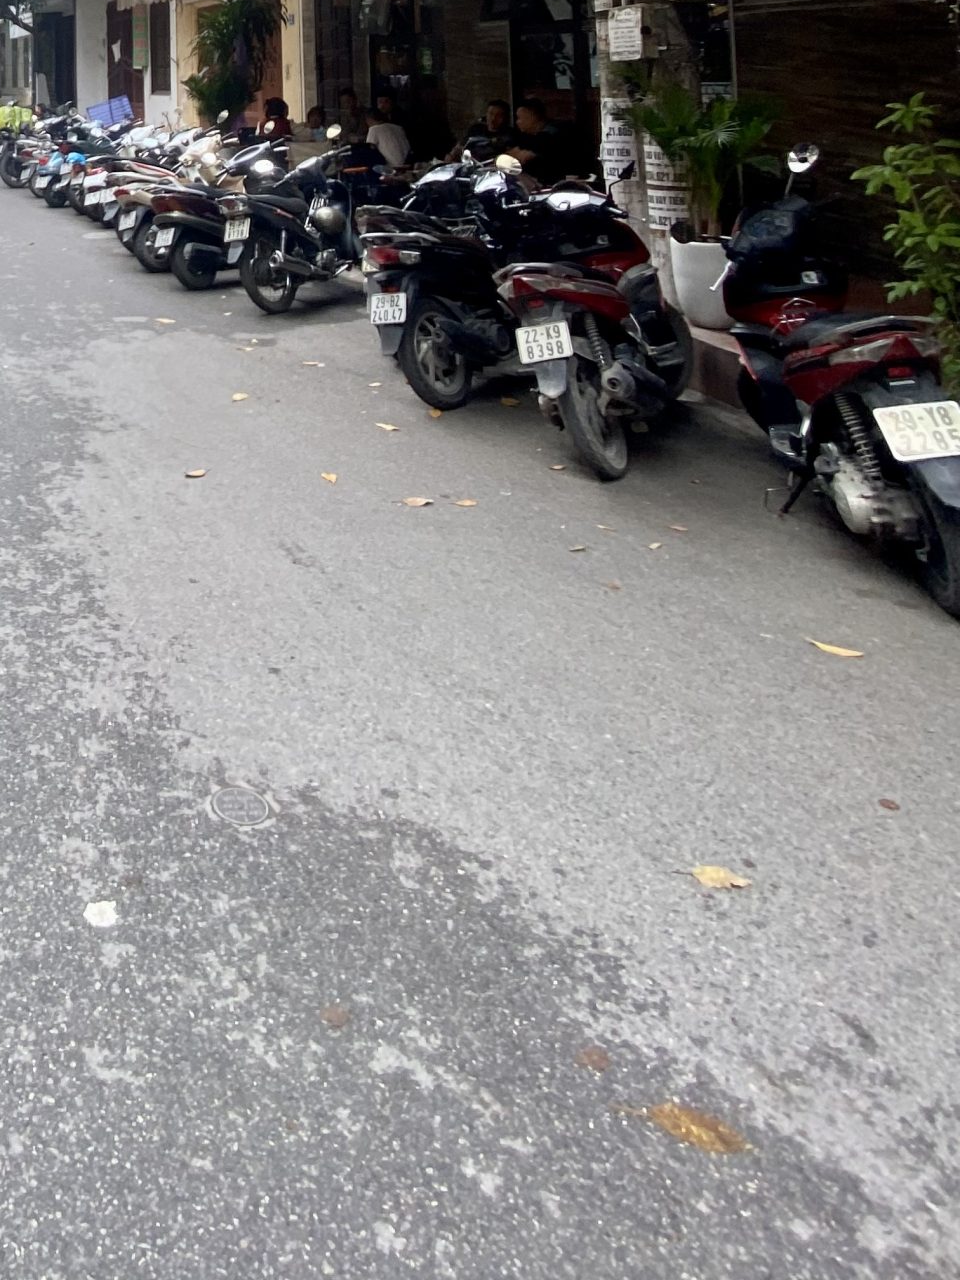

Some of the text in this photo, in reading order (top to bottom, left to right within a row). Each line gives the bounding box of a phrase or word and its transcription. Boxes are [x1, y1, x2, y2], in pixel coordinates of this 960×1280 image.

[375, 294, 401, 309] 29-B2
[524, 324, 561, 344] 22-K9
[526, 340, 565, 360] 8398
